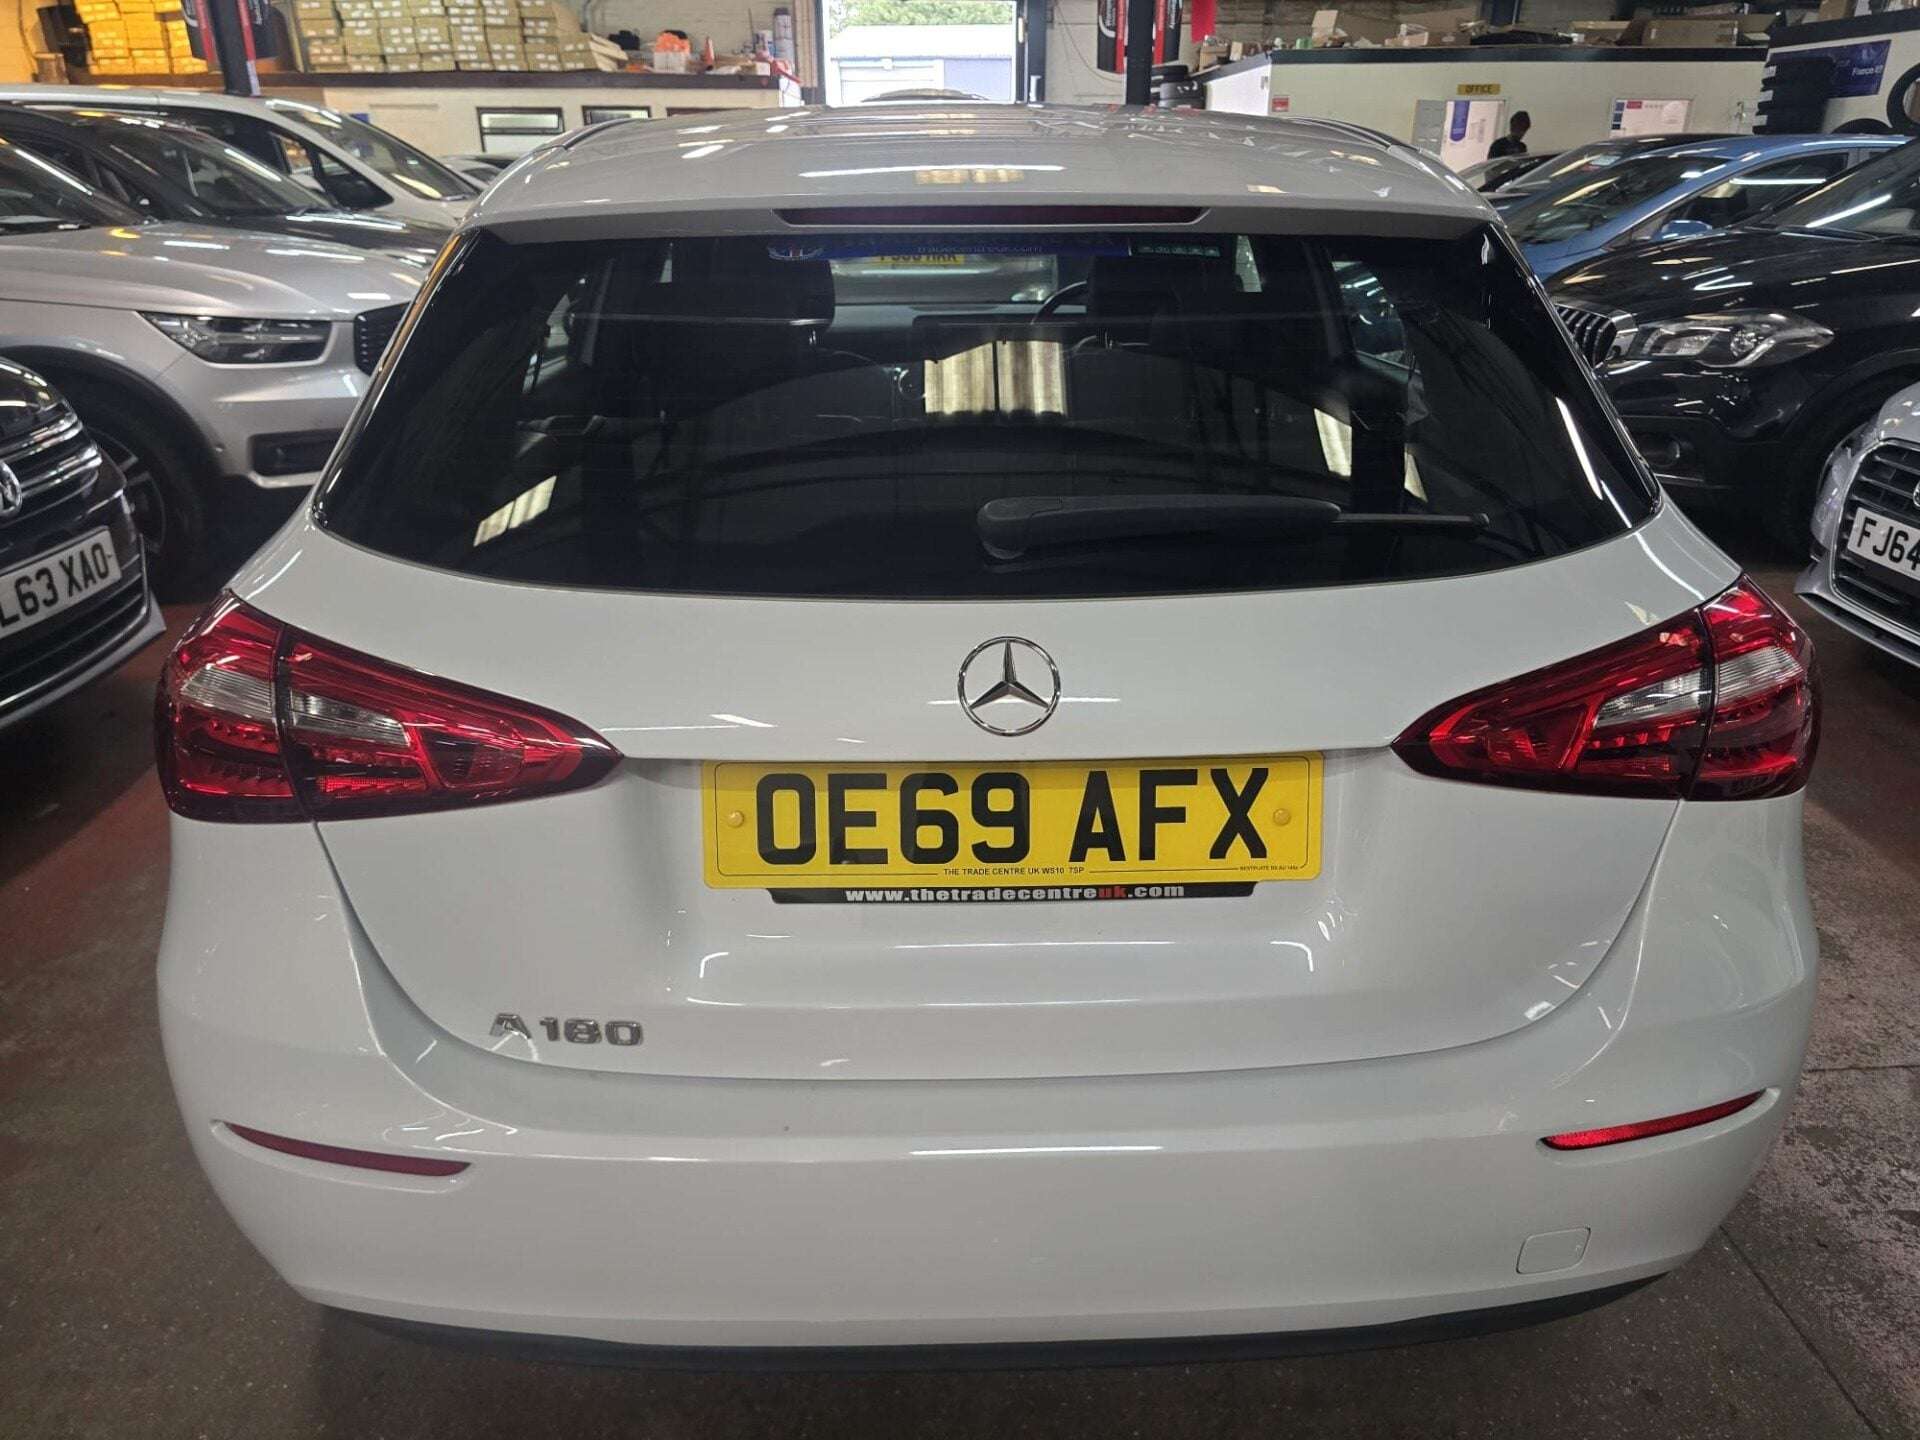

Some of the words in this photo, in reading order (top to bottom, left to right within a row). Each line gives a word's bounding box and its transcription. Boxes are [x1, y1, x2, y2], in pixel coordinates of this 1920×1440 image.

[1465, 84, 1493, 93] OFFICE
[1857, 516, 1920, 571] FJ64
[59, 543, 109, 597] XAO
[756, 772, 1031, 864] OE69
[1069, 768, 1269, 862] AFX
[992, 867, 1025, 875] CENTRE
[845, 885, 1185, 902] www.thetradecentreuk.com
[489, 1013, 532, 1040] A
[539, 1017, 644, 1047] 180
